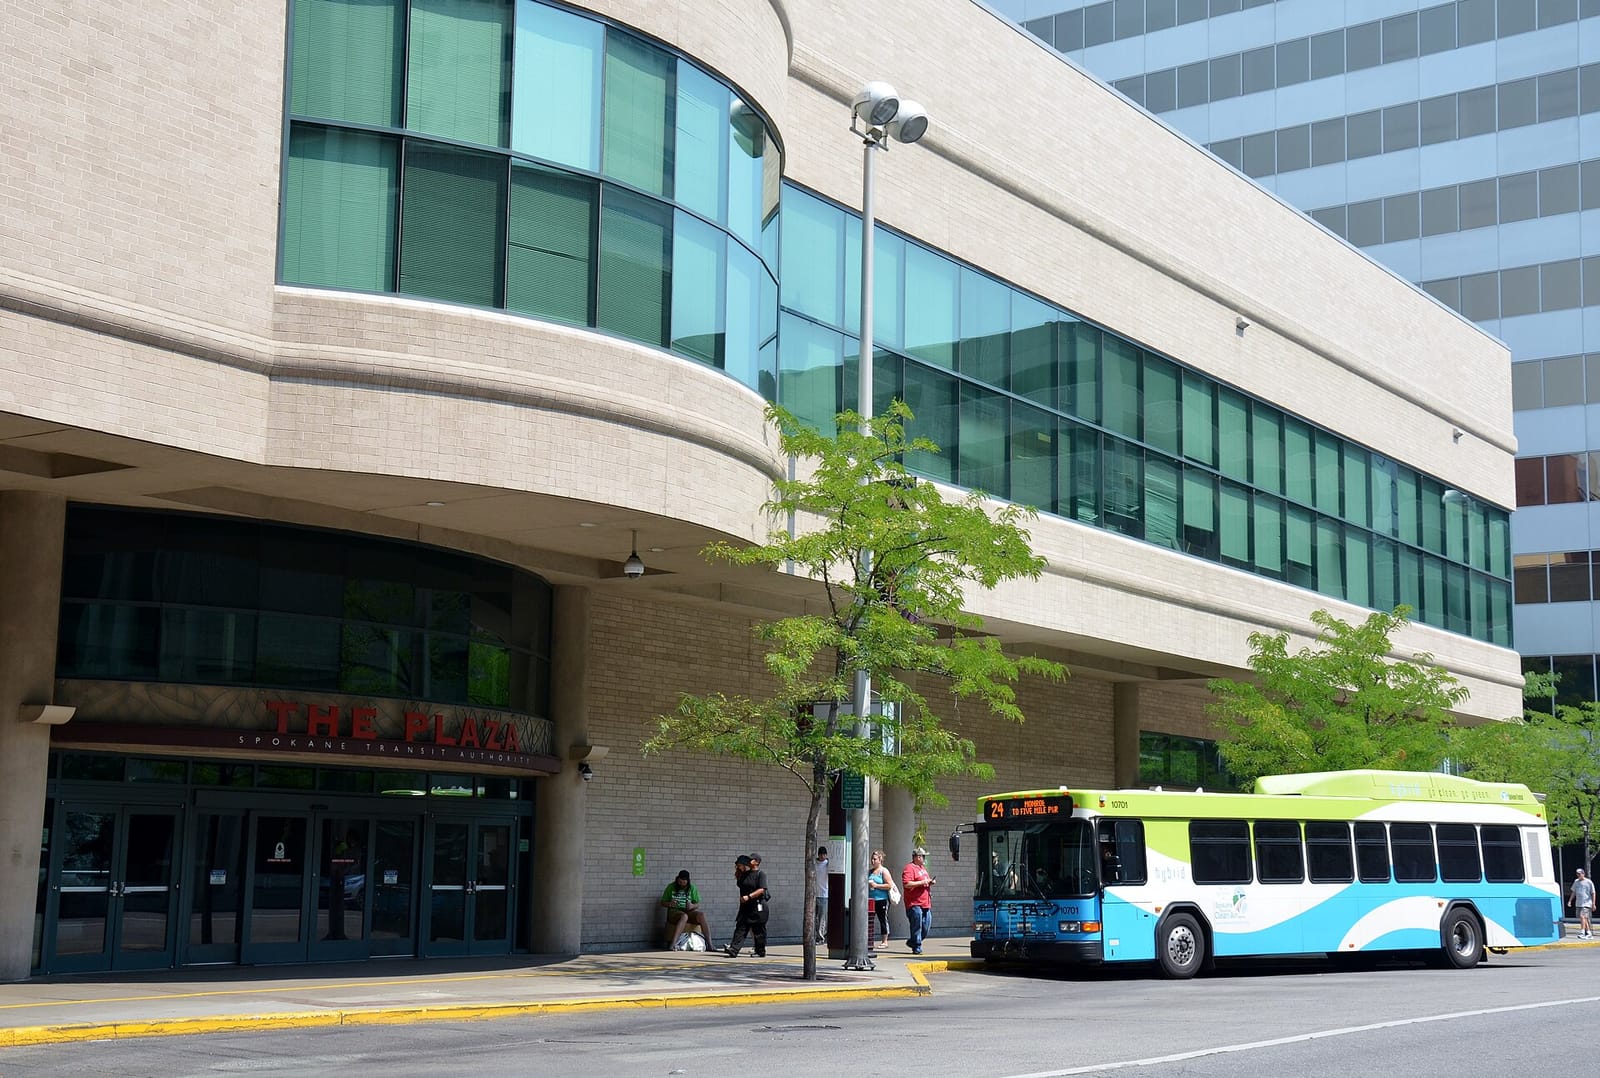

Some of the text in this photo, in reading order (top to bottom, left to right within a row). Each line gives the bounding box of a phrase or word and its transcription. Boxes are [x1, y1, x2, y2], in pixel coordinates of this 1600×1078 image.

[266, 700, 521, 753] THE PLAZA
[239, 735, 530, 764] SPOKANE TRANSIT AUTHORITY
[991, 802, 1004, 818] 24
[1012, 808, 1020, 816] TO
[1020, 807, 1033, 816] FIVE
[1034, 806, 1047, 815] MILE
[1111, 800, 1128, 809] 10701
